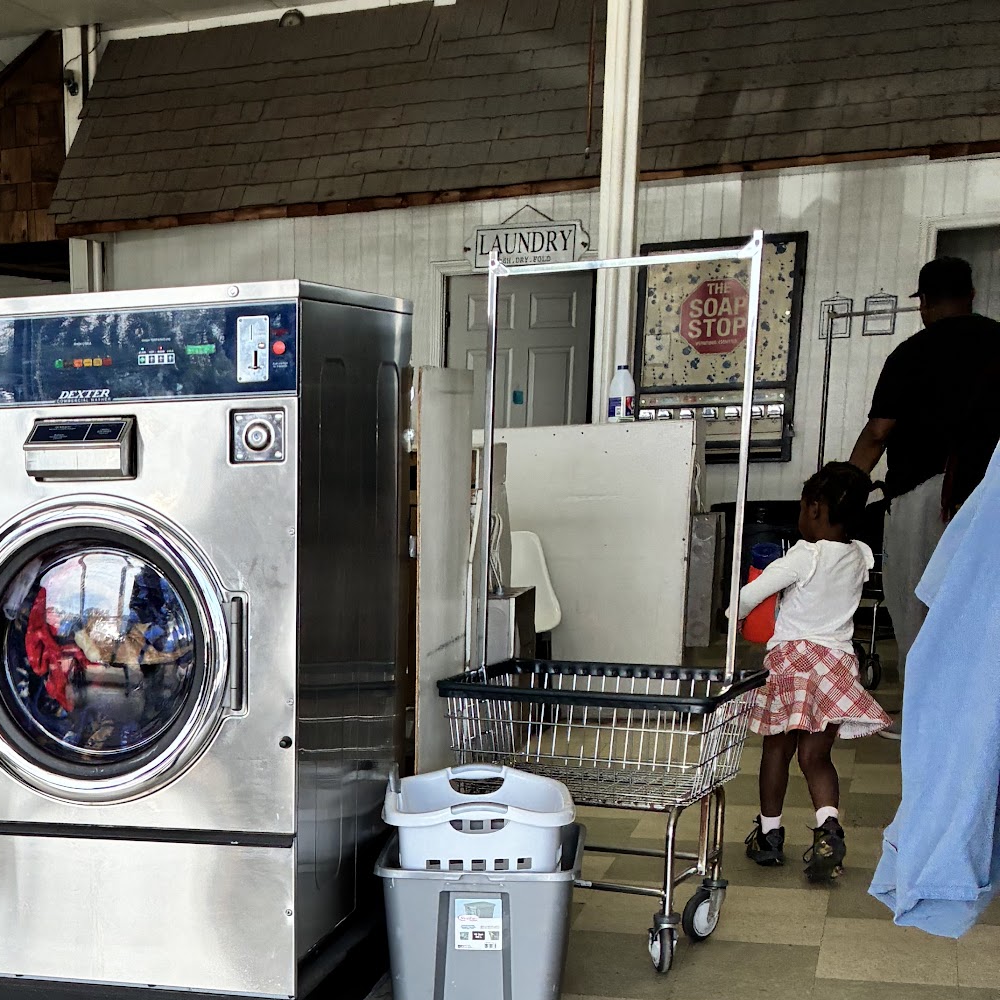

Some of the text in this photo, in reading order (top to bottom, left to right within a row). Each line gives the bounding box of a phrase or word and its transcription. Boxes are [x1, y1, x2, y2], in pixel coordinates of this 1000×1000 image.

[479, 229, 572, 255] LAUNDRY
[707, 282, 731, 295] THE
[689, 297, 745, 318] SOAP
[688, 317, 746, 339] STOP
[58, 389, 110, 399] DEXTER
